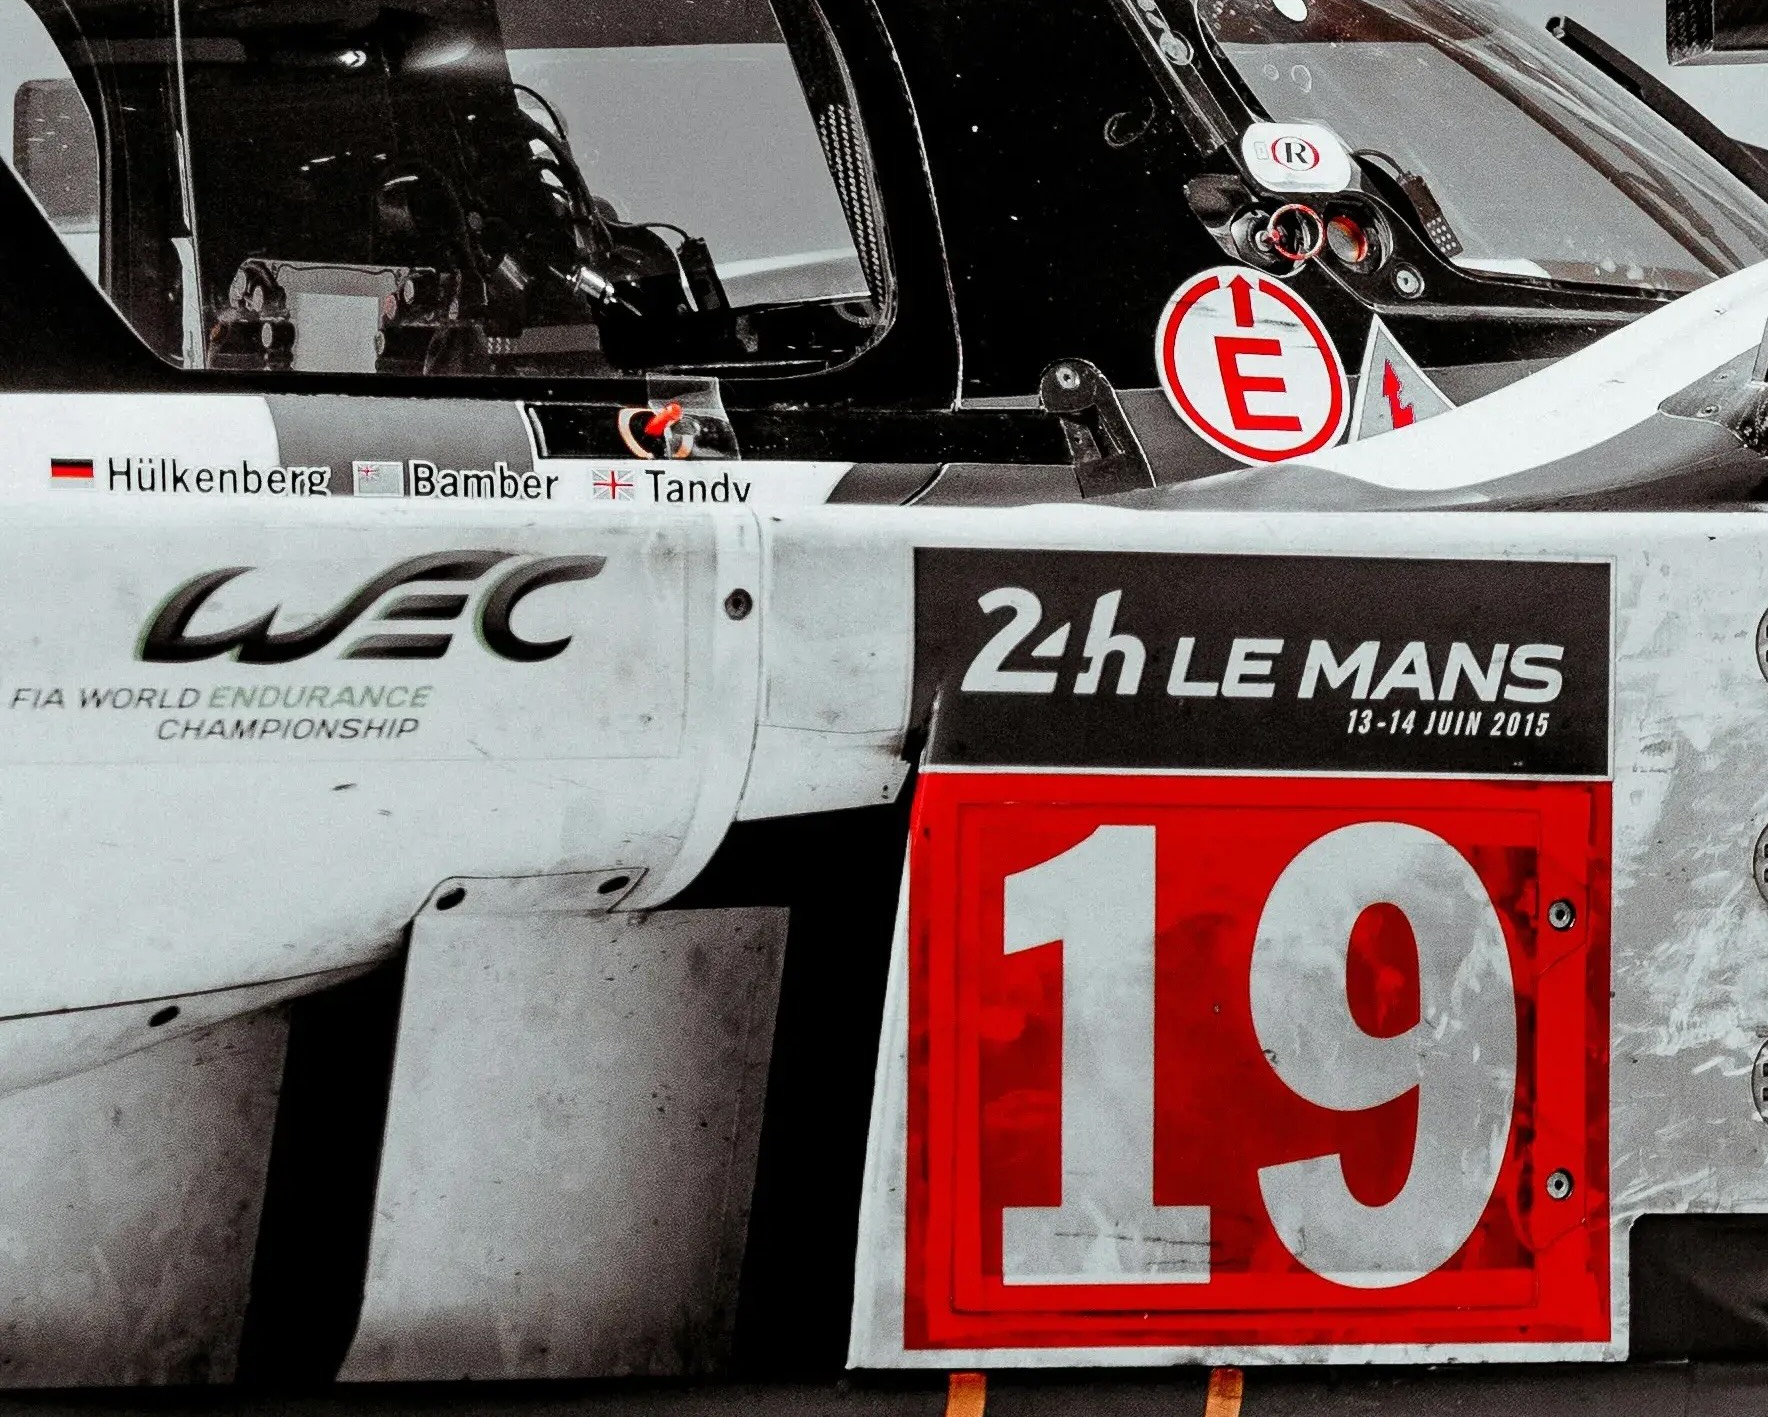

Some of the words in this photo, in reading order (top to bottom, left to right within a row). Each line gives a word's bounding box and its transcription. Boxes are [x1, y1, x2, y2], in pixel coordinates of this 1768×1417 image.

[1215, 335, 1301, 432] E
[107, 456, 331, 497] Hülkenberg
[413, 461, 559, 500] Bamber
[133, 549, 608, 664] WEC
[962, 587, 1146, 696] 24h
[1168, 639, 1284, 699] LE
[1297, 641, 1564, 704] MANS
[9, 686, 66, 709] FIA
[78, 686, 200, 709] WORLD
[207, 684, 433, 709] ENDURANCE
[156, 717, 420, 741] CHAMPIONSHIP
[1346, 708, 1417, 736] 13-14
[1424, 710, 1482, 737] JUIN
[1490, 710, 1550, 739] 2015
[1002, 821, 1517, 1289] 19
